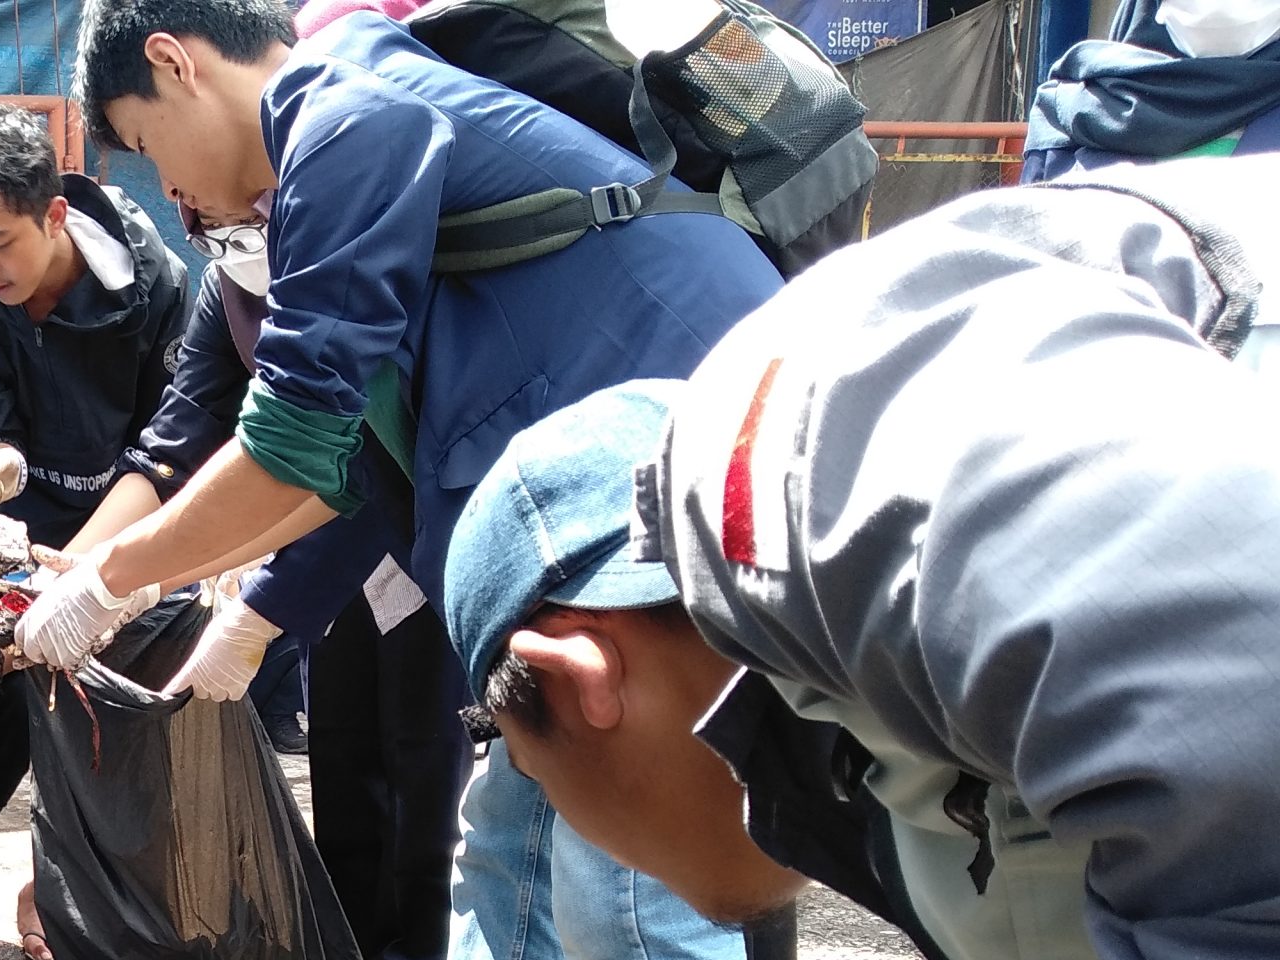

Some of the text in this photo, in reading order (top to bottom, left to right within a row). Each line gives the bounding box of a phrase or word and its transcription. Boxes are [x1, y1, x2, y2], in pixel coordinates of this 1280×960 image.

[842, 17, 889, 34] Better
[827, 29, 870, 52] Sleep
[47, 470, 61, 486] US
